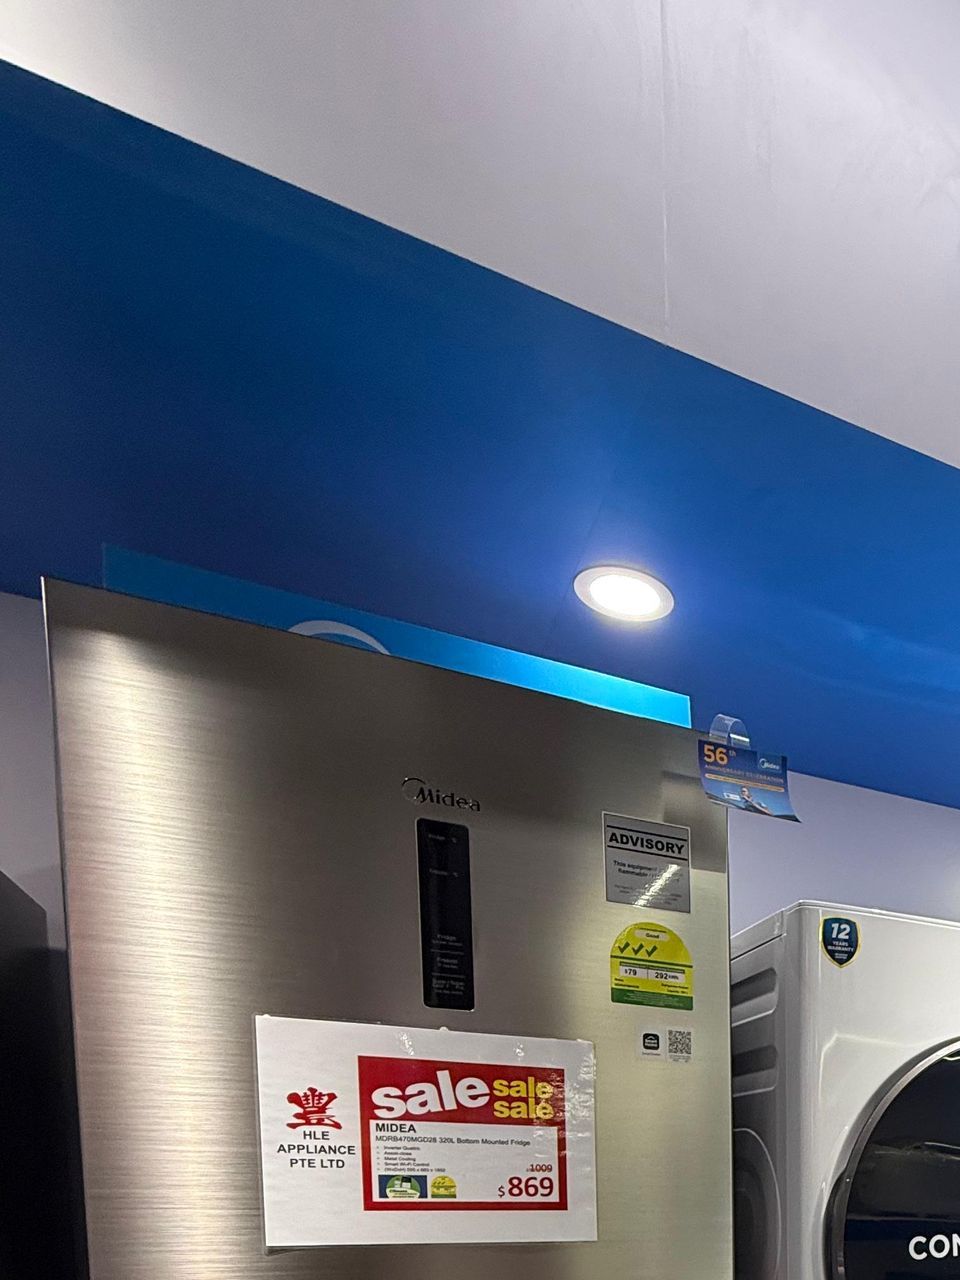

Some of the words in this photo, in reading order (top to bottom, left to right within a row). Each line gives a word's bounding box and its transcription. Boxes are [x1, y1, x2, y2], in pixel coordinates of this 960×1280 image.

[401, 776, 480, 812] Midea
[609, 832, 684, 855] ADVISORY
[832, 923, 850, 939] 12
[371, 1070, 490, 1119] sale
[492, 1077, 554, 1098] sale
[493, 1098, 554, 1120] sale
[303, 1130, 330, 1141] HLE
[375, 1123, 416, 1134] MIDEA
[277, 1144, 356, 1155] APPLIANCE
[457, 1137, 480, 1145] Bottom
[481, 1138, 509, 1146] Mounted
[290, 1158, 316, 1168] PTE
[320, 1159, 345, 1168] LTD
[498, 1176, 554, 1199] $869
